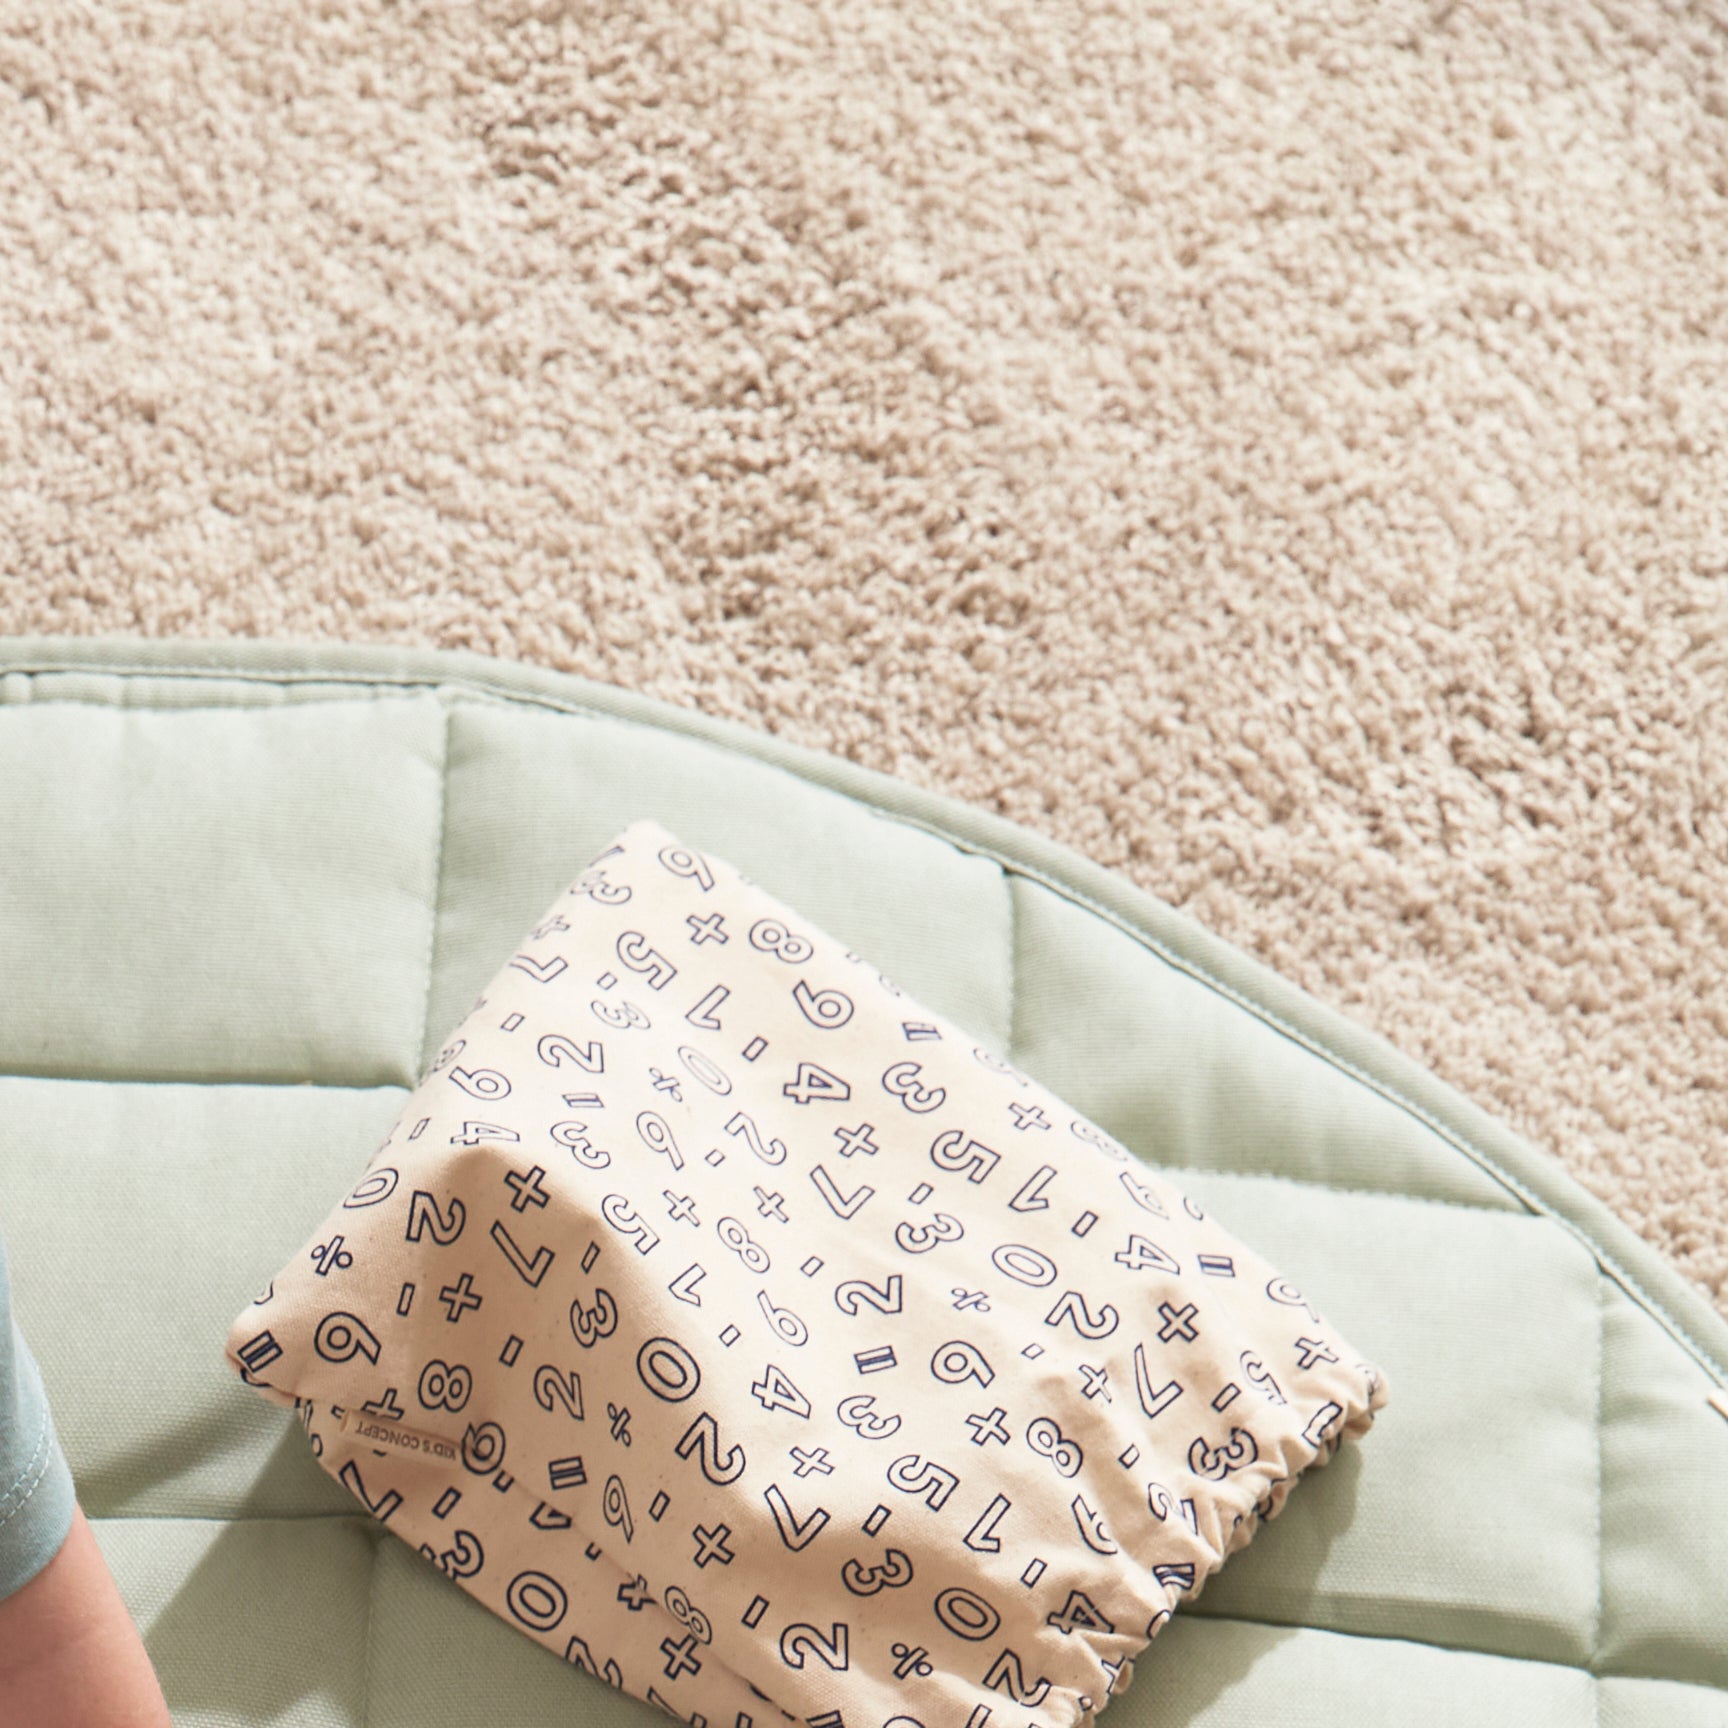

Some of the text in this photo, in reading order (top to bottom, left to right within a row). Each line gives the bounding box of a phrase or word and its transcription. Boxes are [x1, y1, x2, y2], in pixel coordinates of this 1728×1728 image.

[618, 933, 676, 990] 5
[749, 921, 812, 962] 8
[539, 1036, 603, 1072] 2
[784, 1064, 849, 1104] 4
[883, 1063, 944, 1113] 3
[451, 1123, 518, 1144] 4
[551, 1123, 609, 1168] 3
[725, 1114, 785, 1164] 2
[931, 1132, 1000, 1183] 5
[406, 1191, 464, 1245] 2
[603, 1196, 659, 1254] 5
[896, 1215, 963, 1253] 3
[718, 1219, 769, 1272] 8
[993, 1246, 1056, 1287] 0
[1116, 1236, 1178, 1274] 4
[571, 1289, 617, 1348] 3
[836, 1276, 901, 1315] 2
[1045, 1292, 1118, 1339] 2
[419, 1361, 471, 1412] 8
[535, 1366, 583, 1420] 2
[637, 1338, 699, 1403] 0
[752, 1366, 810, 1419] 4
[355, 1420, 420, 1451] CONCEPT
[838, 1397, 900, 1438] 3
[676, 1413, 744, 1486] 2
[1027, 1418, 1083, 1477] 8
[888, 1456, 958, 1511] 5
[842, 1550, 912, 1596] 3
[507, 1572, 567, 1631] 0
[664, 1585, 712, 1645] 8
[935, 1589, 1000, 1640] 0
[780, 1624, 847, 1670] 2
[983, 1649, 1054, 1706] 2
